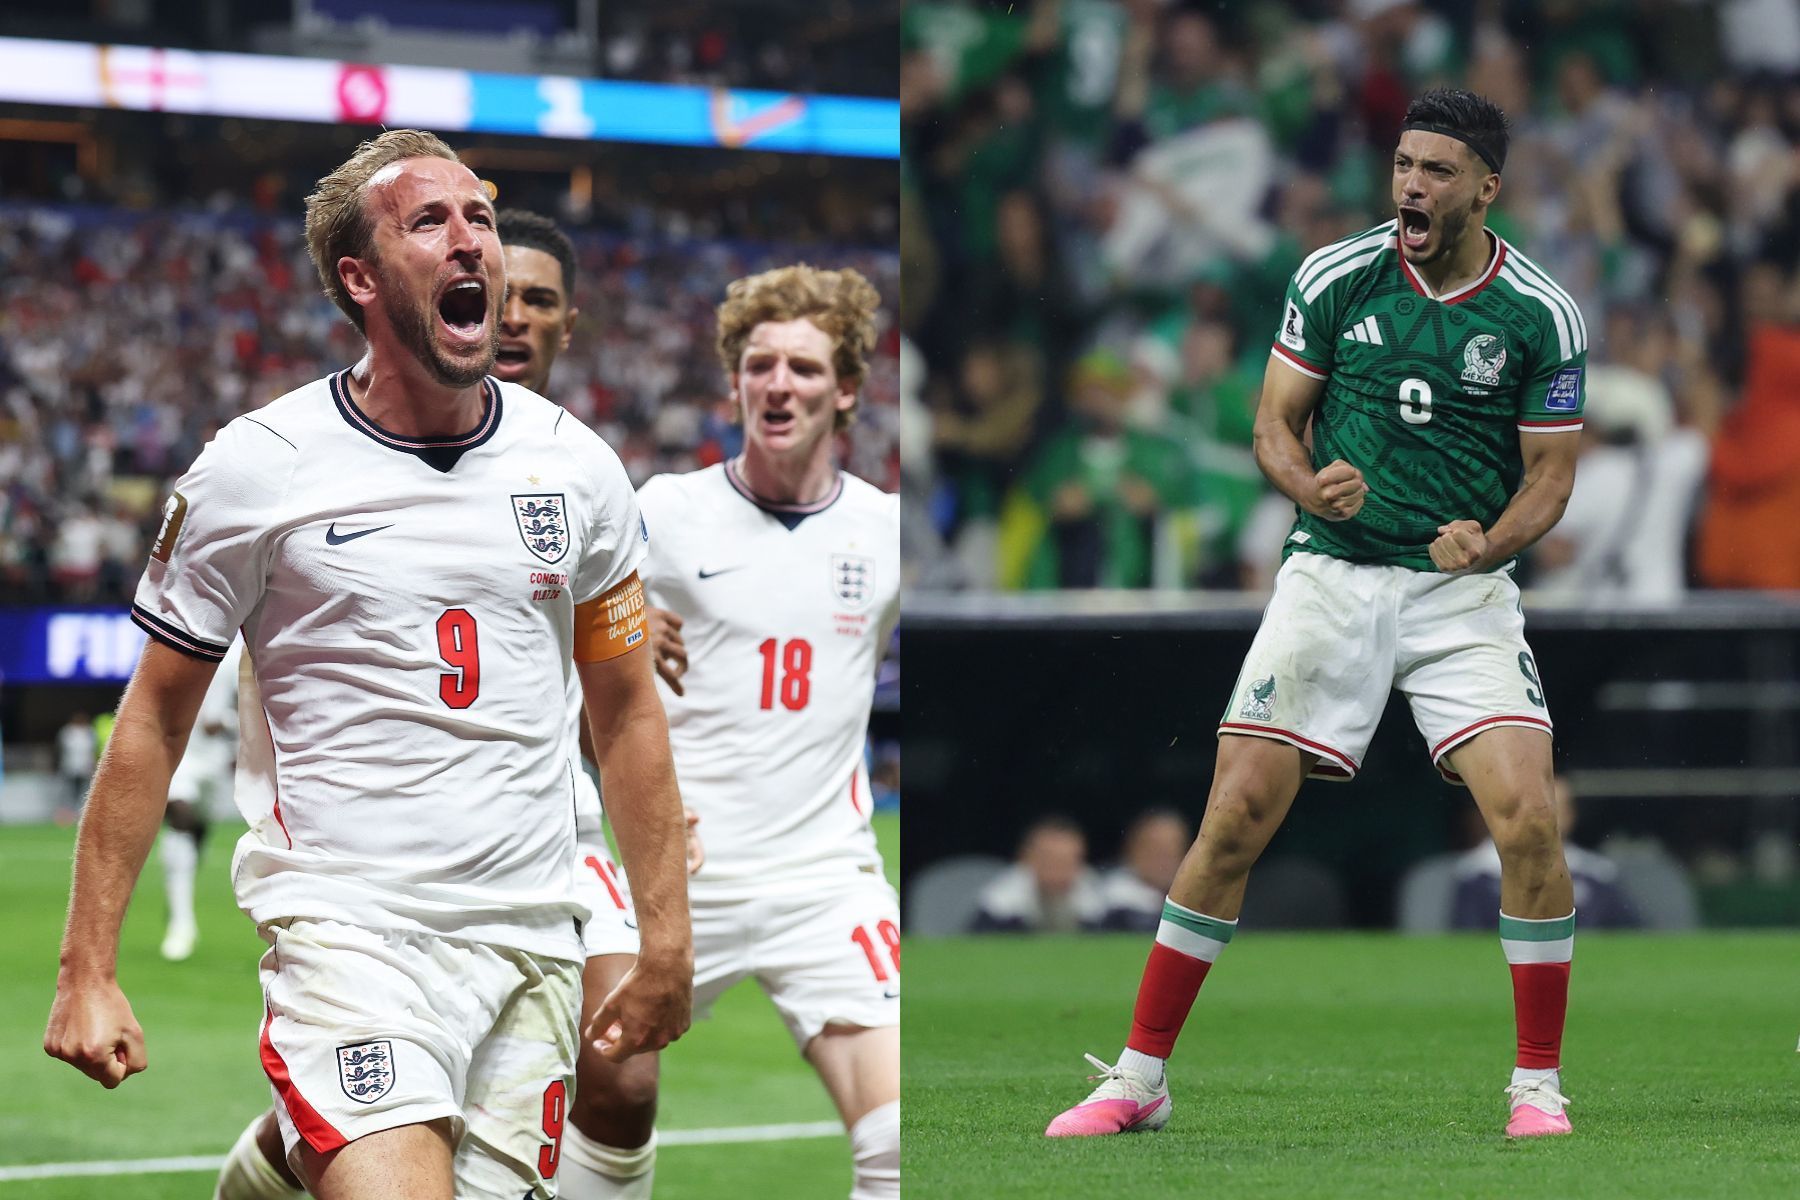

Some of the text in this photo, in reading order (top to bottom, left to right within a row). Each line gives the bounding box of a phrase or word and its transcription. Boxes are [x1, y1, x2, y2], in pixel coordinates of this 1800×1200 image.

[1399, 378, 1432, 424] 9
[530, 572, 560, 584] CONGO
[608, 589, 645, 624] UNITES
[608, 623, 628, 640] the
[47, 613, 147, 679] FIF
[436, 608, 480, 709] 9
[626, 631, 642, 645] FIFA
[759, 637, 813, 712] 18
[1518, 651, 1545, 708] 9
[538, 1079, 566, 1180] 9
